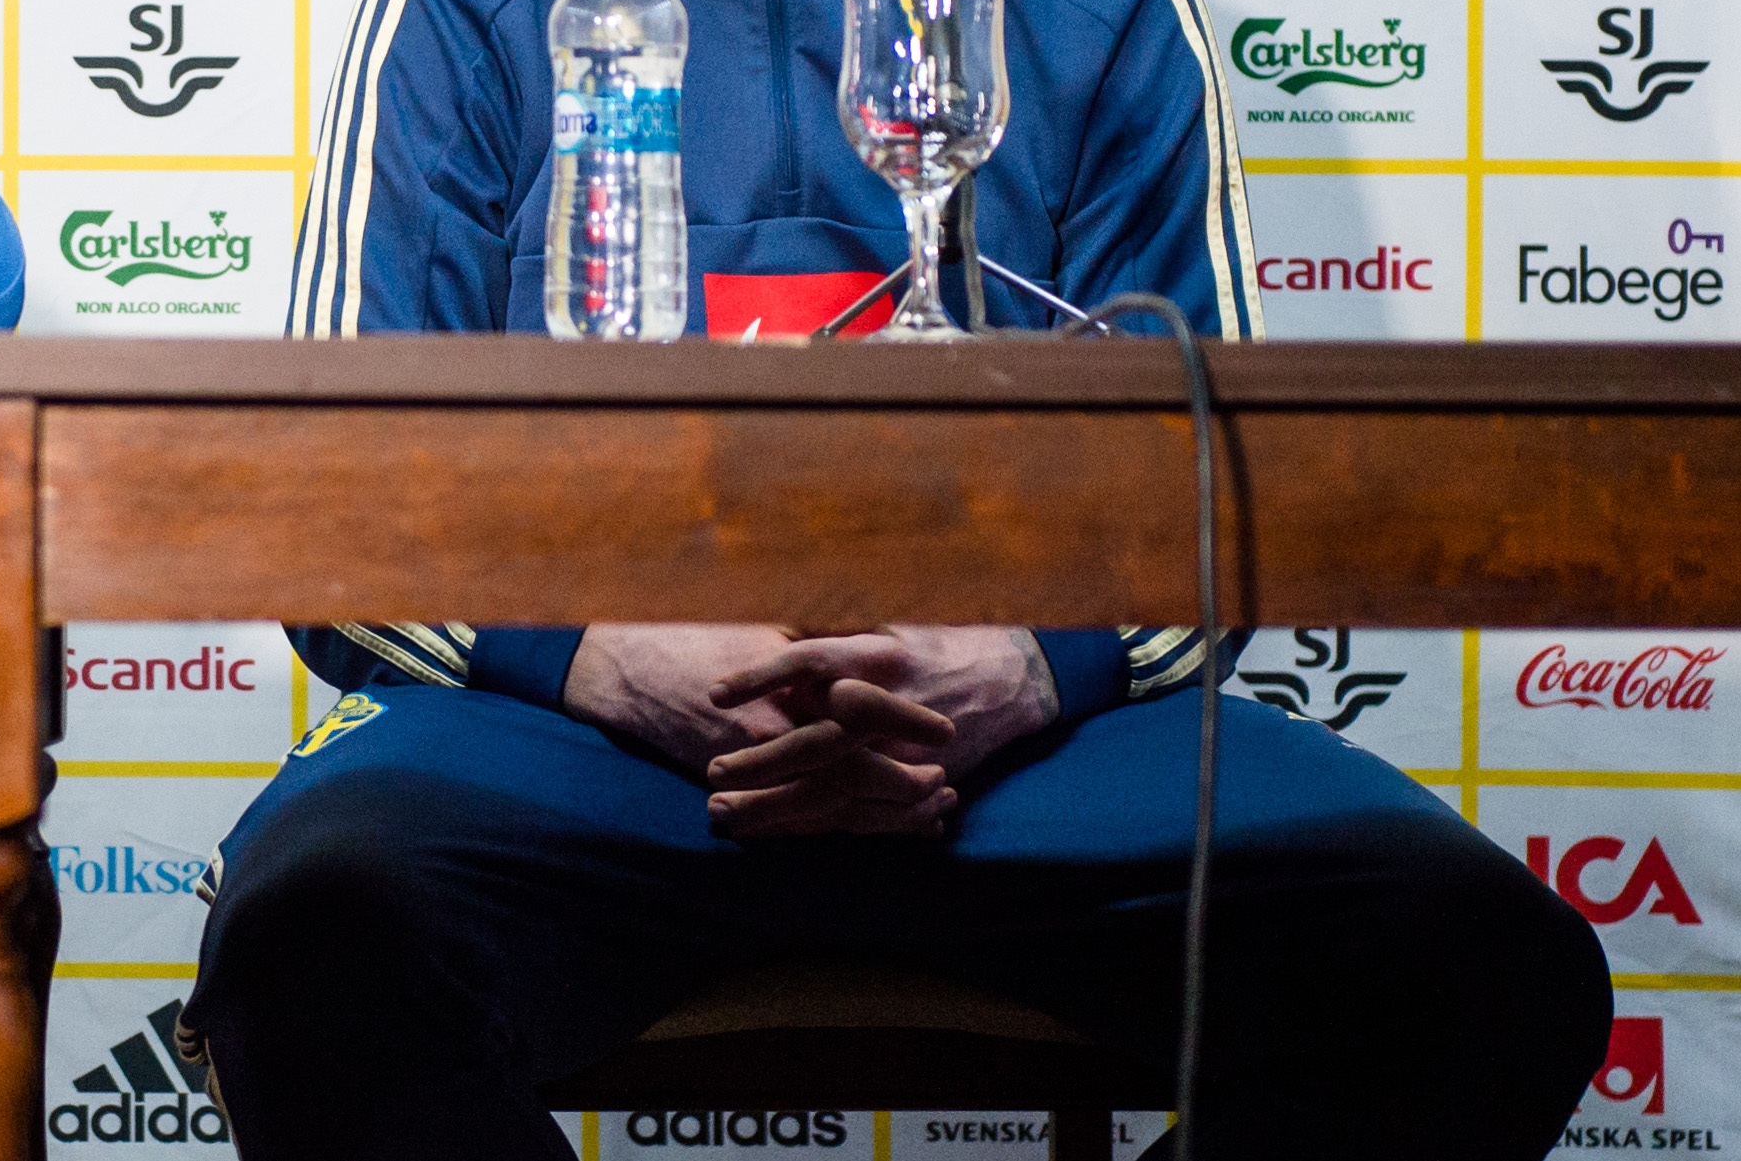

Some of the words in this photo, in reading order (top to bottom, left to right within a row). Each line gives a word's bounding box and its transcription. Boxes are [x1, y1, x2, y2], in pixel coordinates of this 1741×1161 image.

[129, 4, 183, 56] SJ
[1230, 17, 1426, 82] Carlsberg
[1597, 7, 1653, 60] SJ
[1248, 111, 1284, 122] NON
[1289, 110, 1333, 123] ALCO
[1336, 111, 1413, 123] ORGANIC
[60, 209, 252, 273] Carlsberg
[1259, 247, 1433, 292] candic
[1519, 244, 1723, 322] Fabege
[76, 302, 112, 313] NON
[117, 302, 160, 314] ALCO
[165, 302, 240, 314] ORGANIC
[1294, 626, 1351, 674] SJ
[1515, 642, 1726, 712] Coca-Cola
[53, 845, 206, 894] Folksa
[47, 1089, 232, 1145] adida
[1650, 1126, 1722, 1154] SPEL
